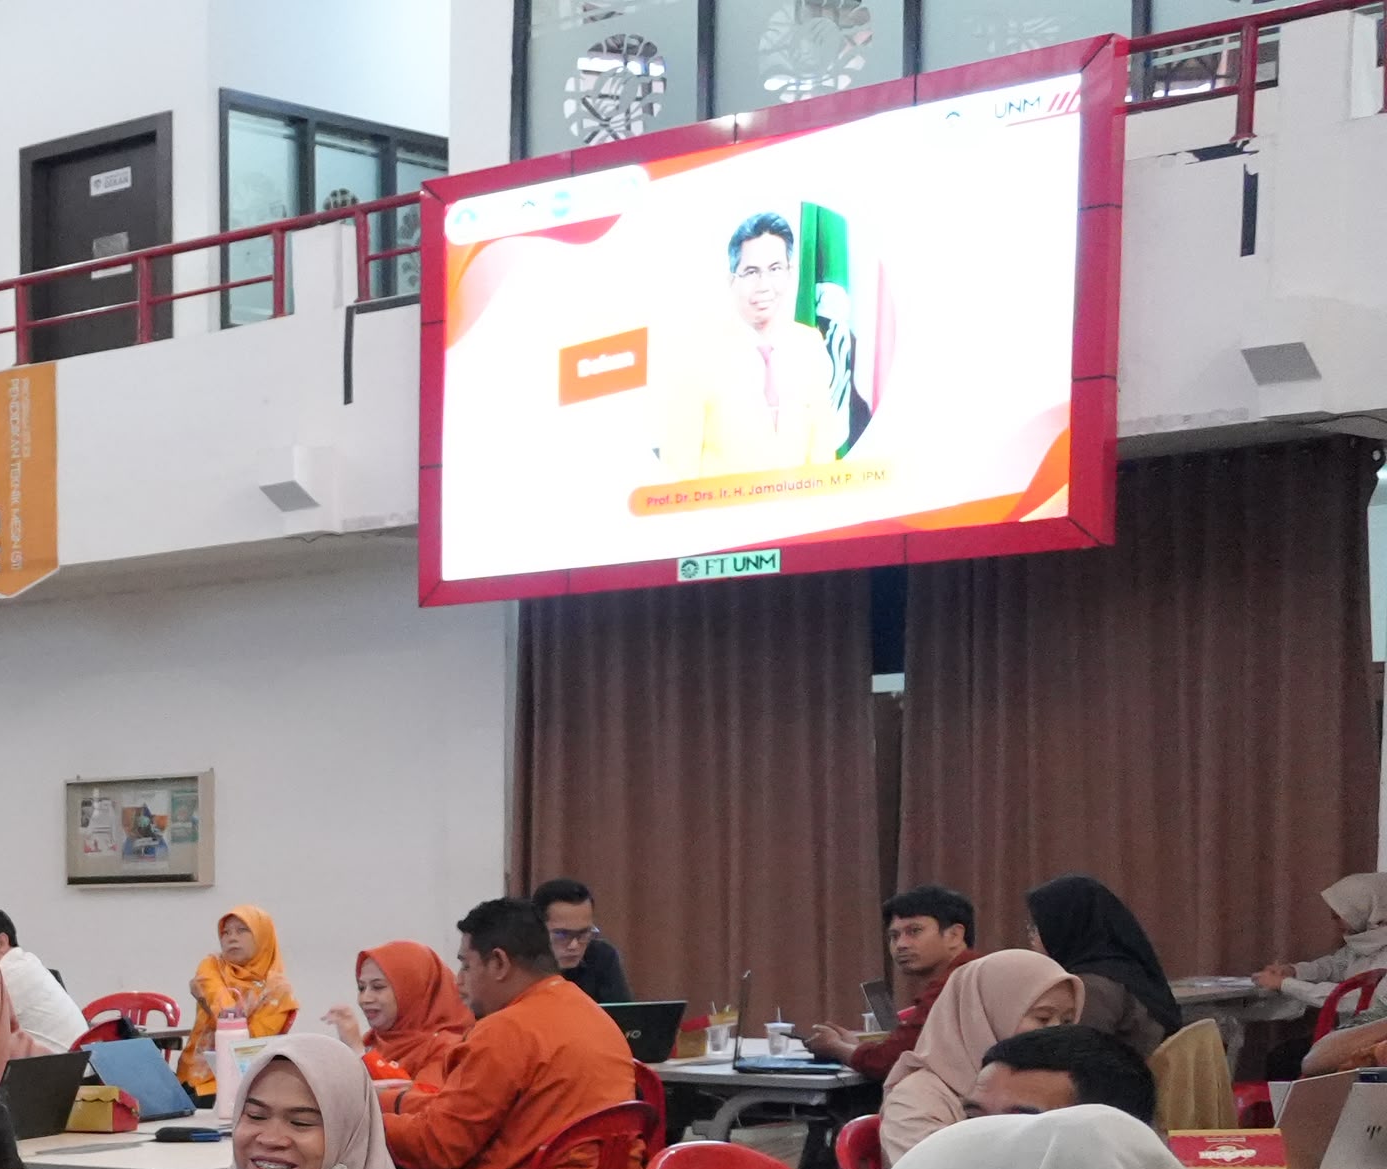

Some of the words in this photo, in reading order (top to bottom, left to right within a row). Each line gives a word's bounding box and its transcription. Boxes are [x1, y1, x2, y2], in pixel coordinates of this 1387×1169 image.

[994, 96, 1041, 118] UNM
[705, 557, 728, 576] FT
[733, 553, 776, 573] UNM
